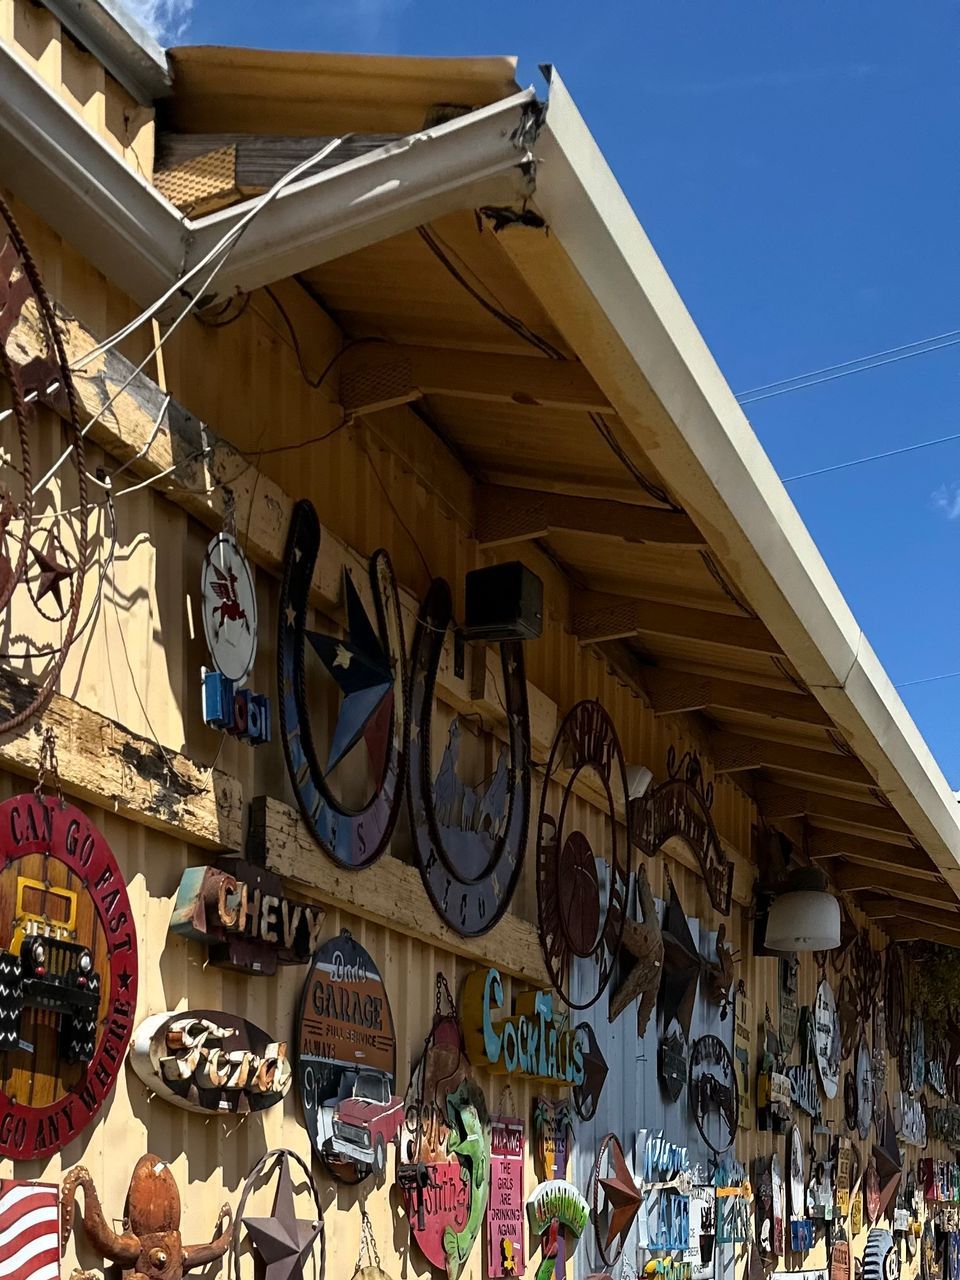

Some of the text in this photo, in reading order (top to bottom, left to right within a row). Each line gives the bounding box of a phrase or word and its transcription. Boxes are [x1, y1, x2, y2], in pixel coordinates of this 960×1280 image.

[9, 804, 56, 845] CAN
[64, 819, 96, 867] GO
[95, 863, 134, 953] FAST
[218, 875, 328, 958] CHEVY
[329, 950, 368, 984] Dad's
[313, 980, 384, 1031] GARAGE
[325, 1023, 377, 1049] FULL SERVICE
[303, 1038, 337, 1062] ALWAYS
[0, 1111, 27, 1150] GO
[499, 1161, 512, 1175] THE
[497, 1177, 514, 1191] GIRLS
[499, 1193, 512, 1206] ARE
[491, 1208, 520, 1221] DRINKING
[497, 1223, 517, 1236] AGAIN
